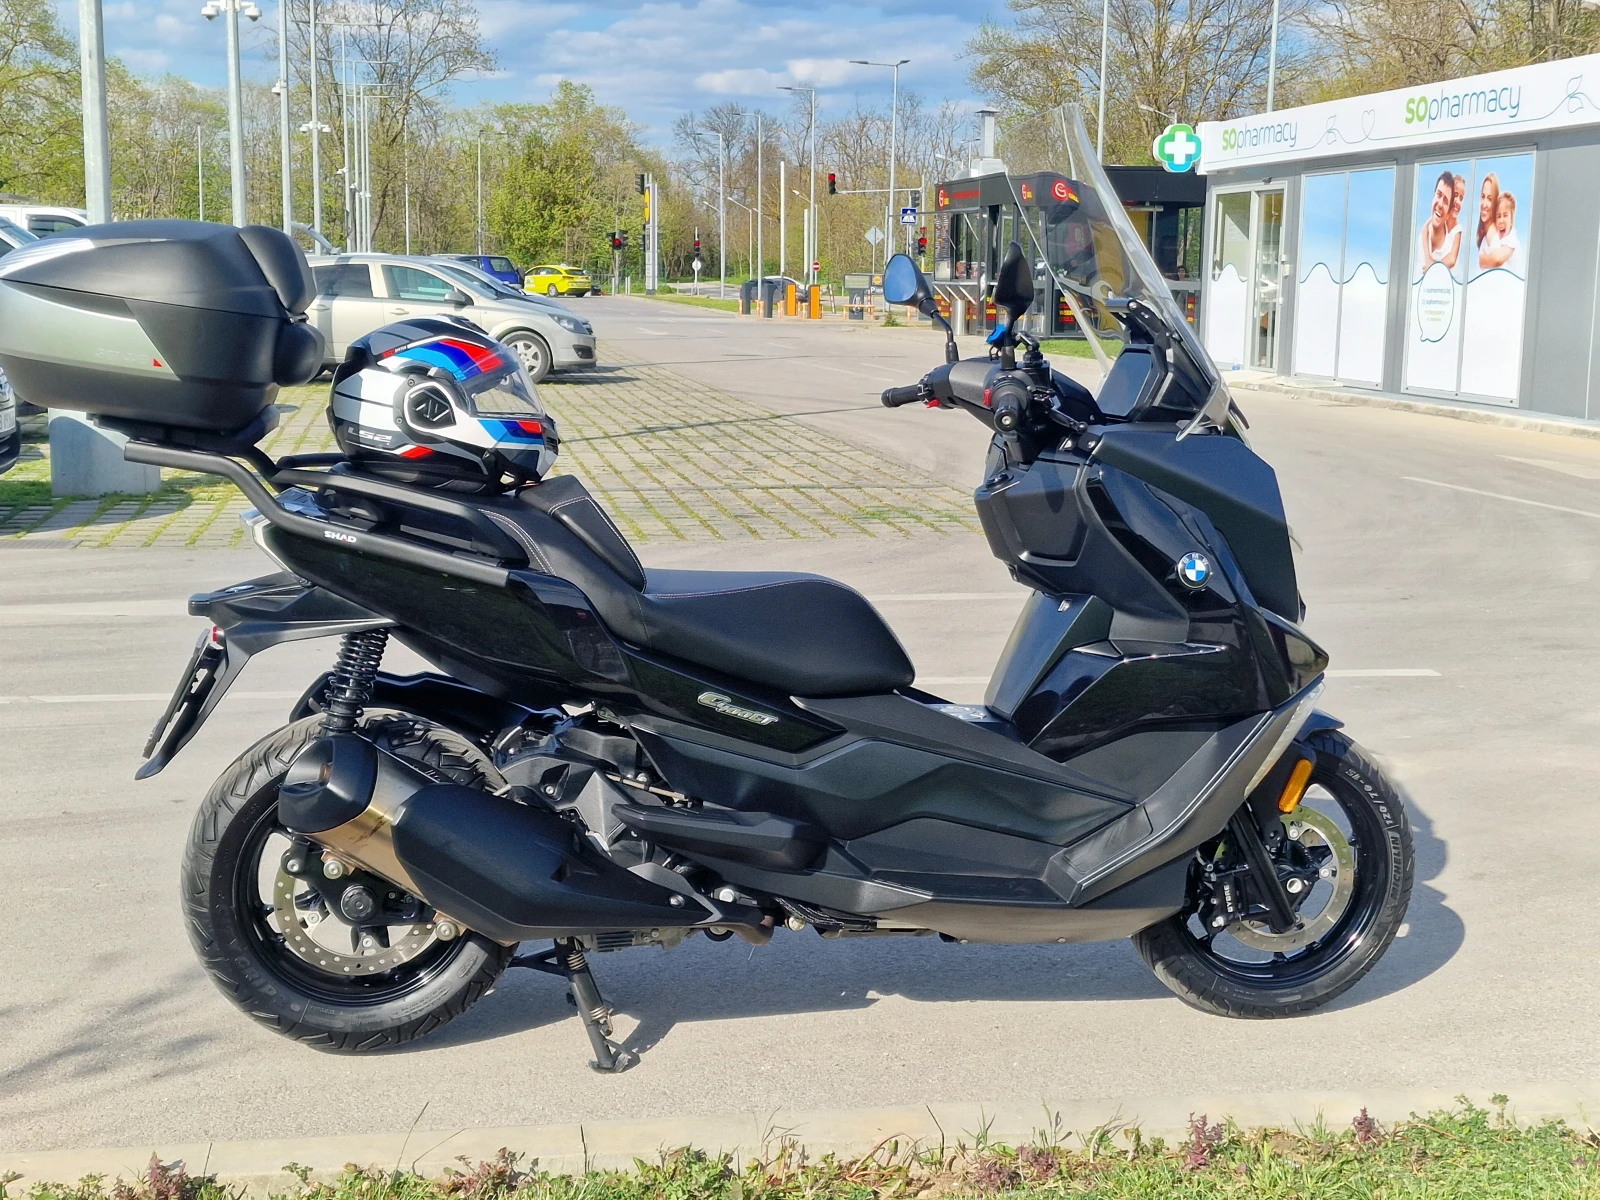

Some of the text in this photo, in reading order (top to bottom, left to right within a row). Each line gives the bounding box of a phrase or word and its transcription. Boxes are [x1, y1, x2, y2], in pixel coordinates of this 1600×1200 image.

[347, 426, 392, 442] LS2
[324, 530, 357, 543] SHAD
[1182, 553, 1209, 566] BMW
[1387, 834, 1402, 900] MICHELIN
